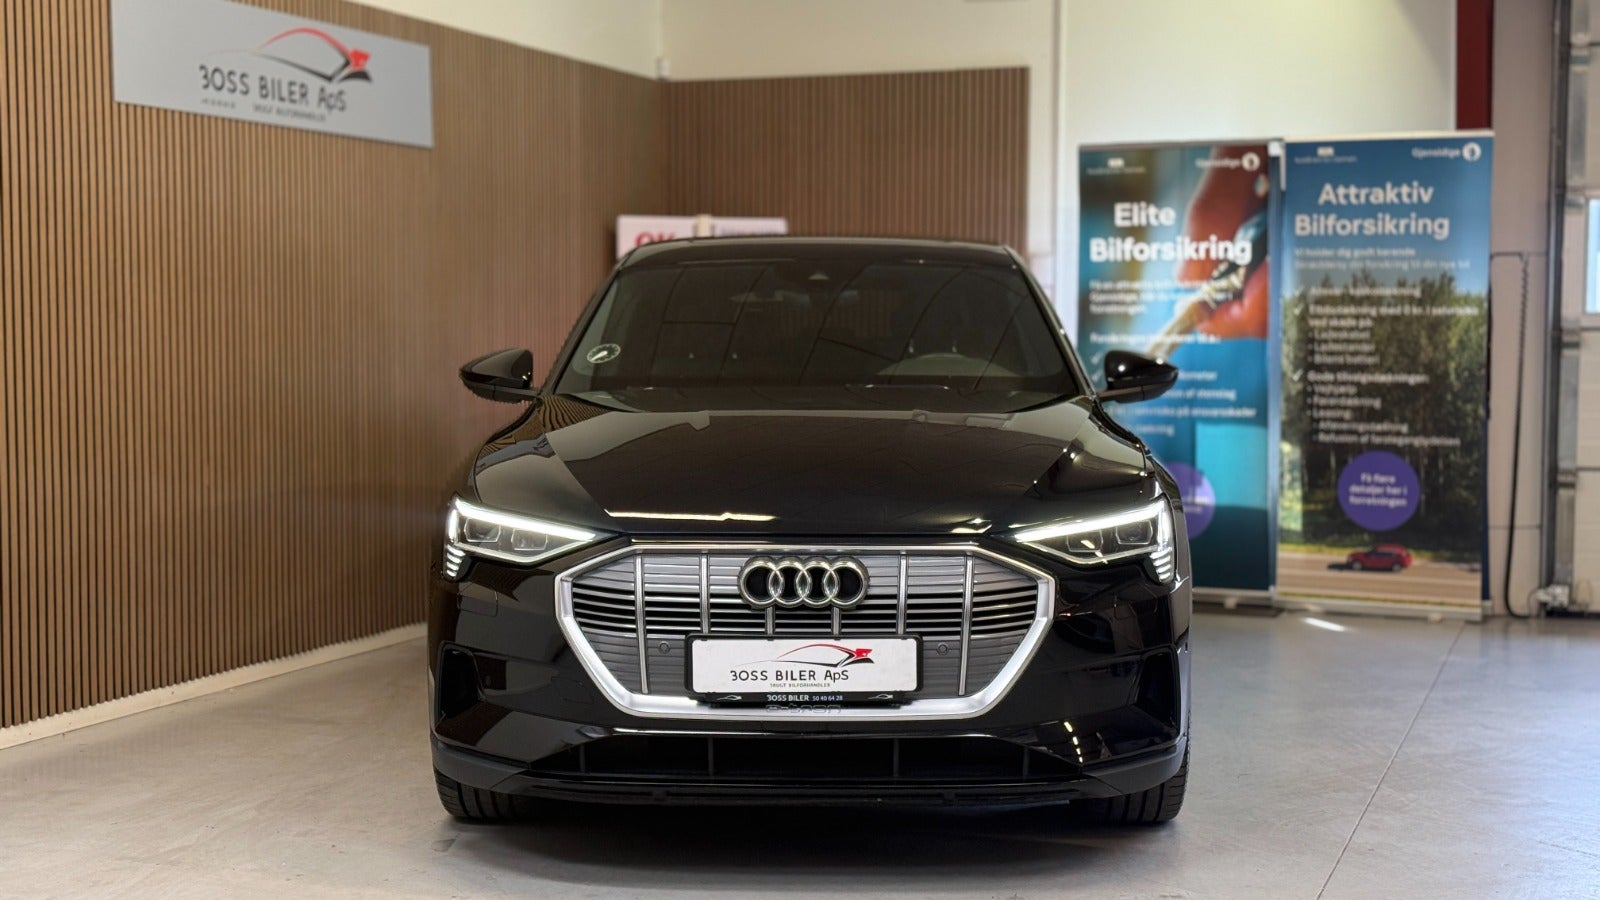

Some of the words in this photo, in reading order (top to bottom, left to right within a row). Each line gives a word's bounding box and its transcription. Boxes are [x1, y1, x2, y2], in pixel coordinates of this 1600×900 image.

[258, 75, 309, 106] BILER
[317, 85, 347, 114] ApS
[1318, 180, 1434, 206] Attraktiv
[1113, 201, 1177, 228] Elite
[1294, 211, 1450, 241] Bilforsikring
[1089, 233, 1253, 266] Bilforsikring
[775, 669, 816, 681] BILER
[823, 669, 849, 684] ApS
[788, 694, 810, 702] BILER
